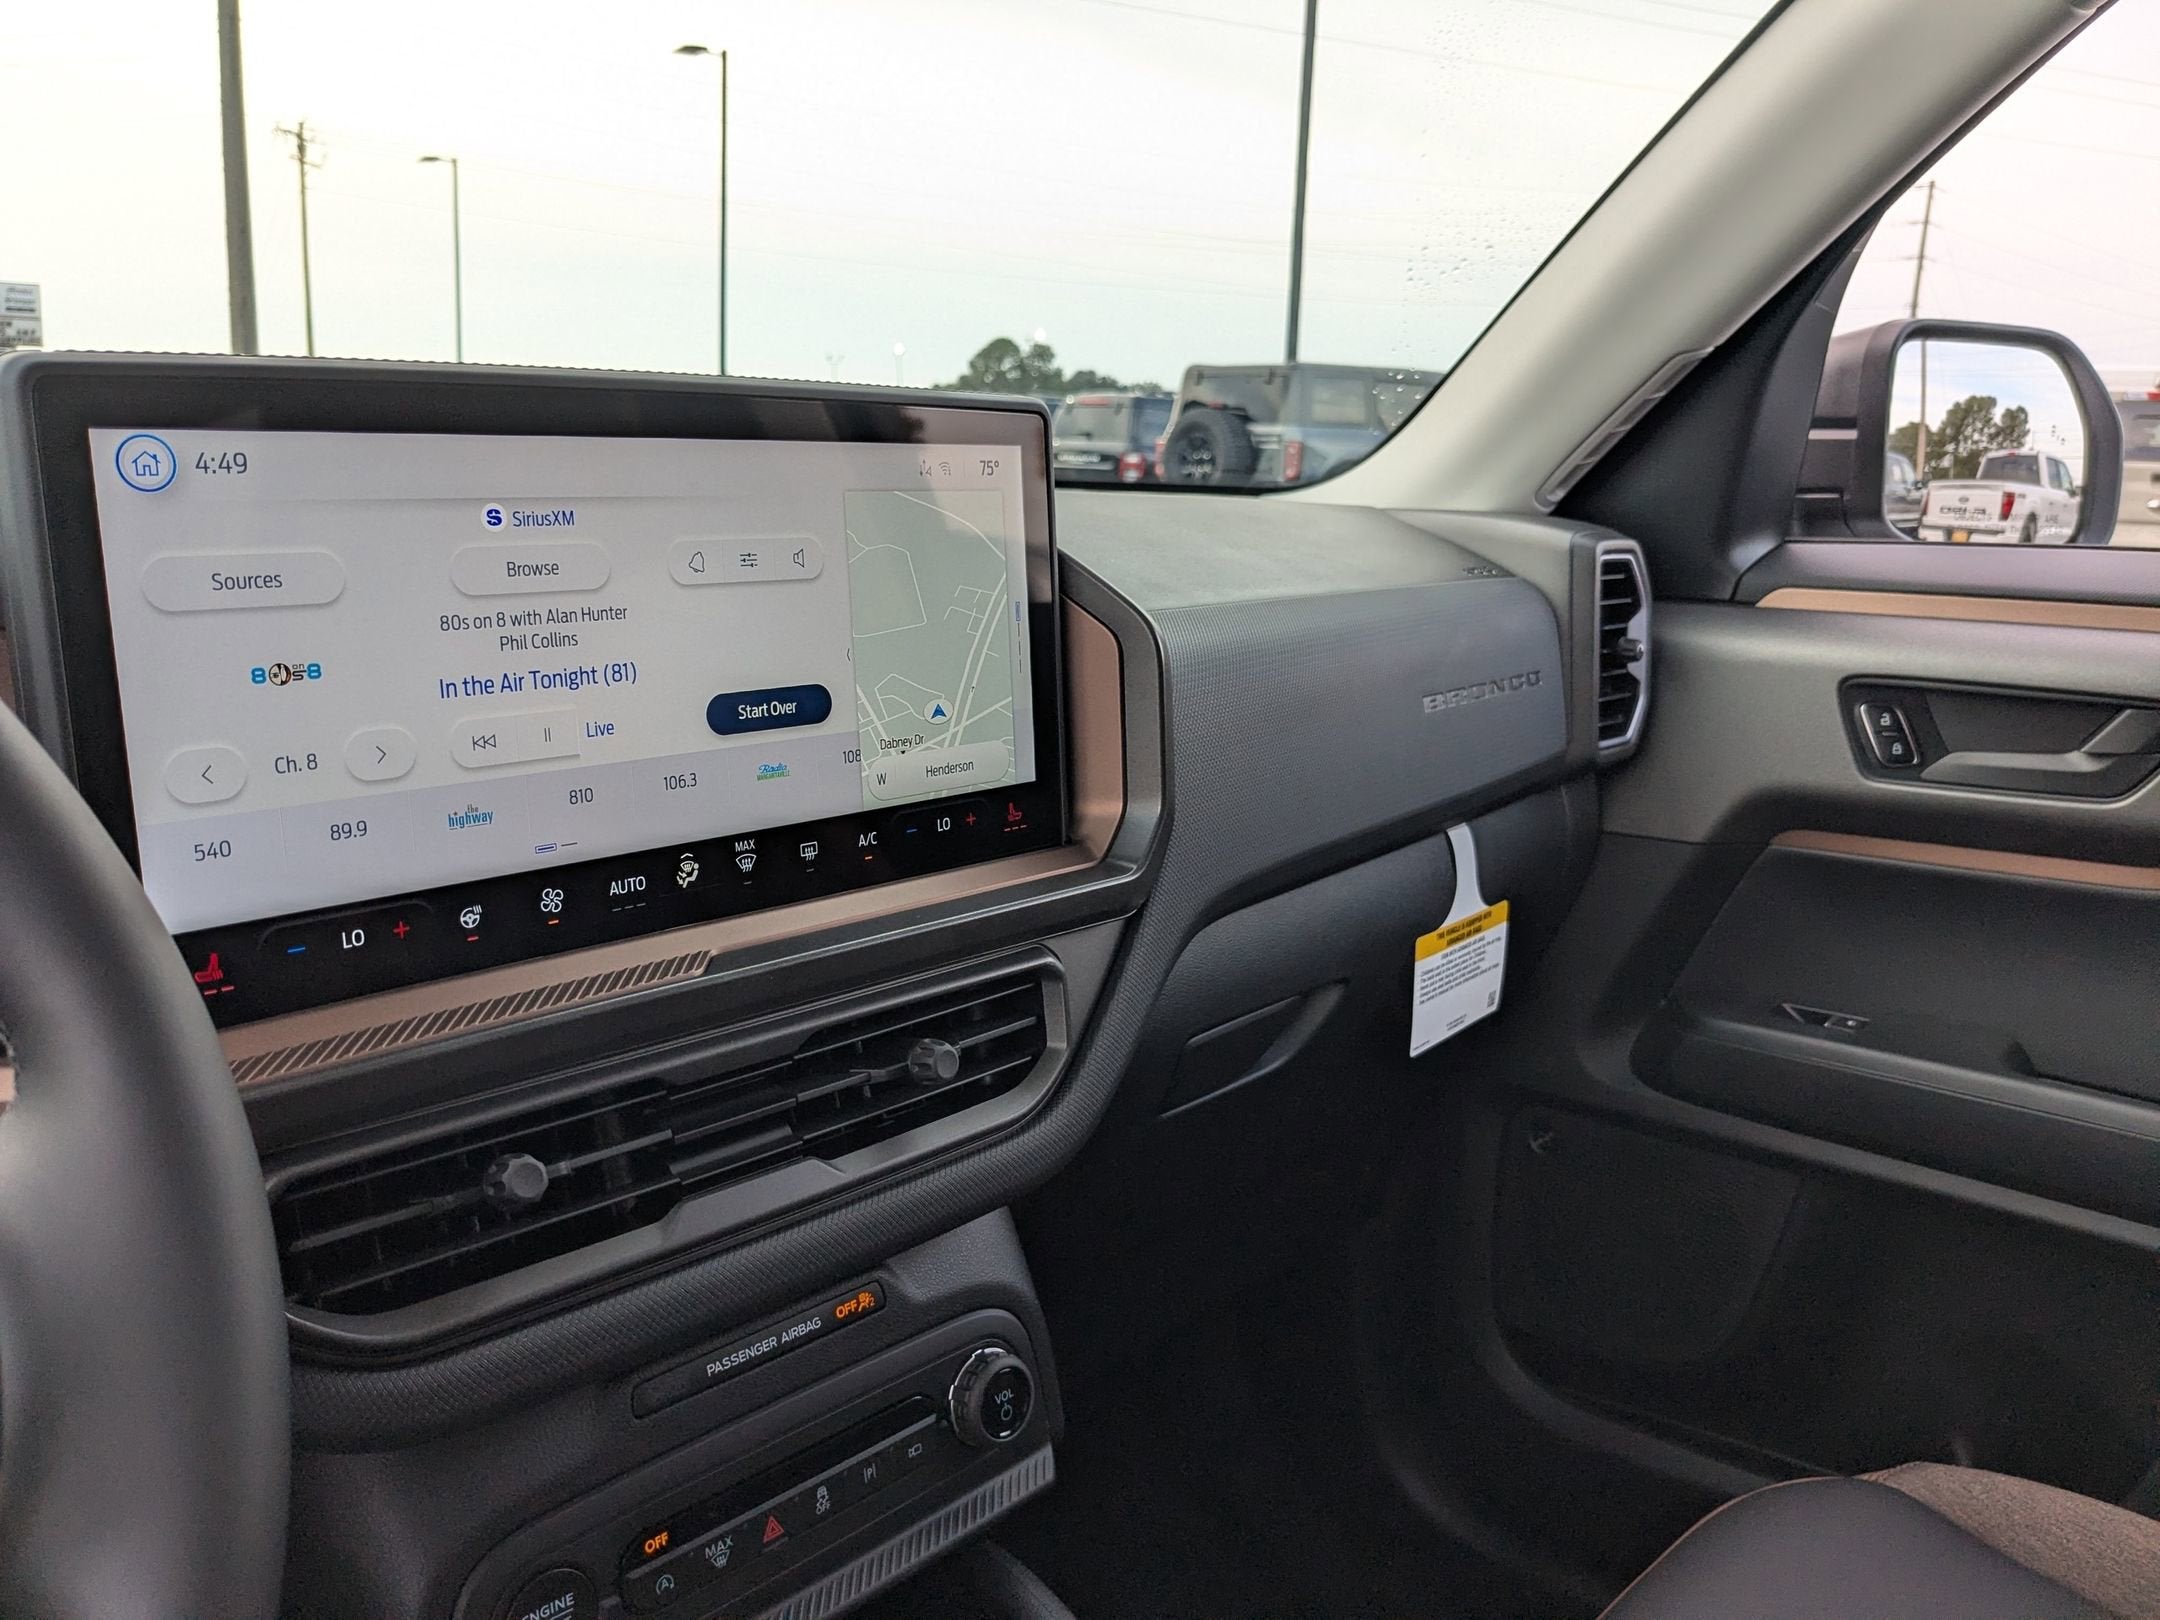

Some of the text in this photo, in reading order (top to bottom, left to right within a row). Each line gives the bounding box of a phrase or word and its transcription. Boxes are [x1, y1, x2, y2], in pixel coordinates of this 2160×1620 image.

[195, 452, 248, 474] 4:49
[512, 510, 575, 527] SiriusXM
[506, 560, 560, 577] Browse
[211, 571, 283, 591] Sources
[440, 605, 628, 631] 80s on 8 with Alan Hunter
[500, 632, 578, 651] Phil Collins
[440, 661, 638, 699] In the Air Tonight (81)
[1422, 670, 1543, 713] BRONCO
[738, 701, 797, 720] Start Over
[586, 722, 615, 738] Live
[880, 734, 925, 751] Dabney Dr
[274, 753, 318, 775] Ch. 8
[926, 760, 974, 778] Henderson
[664, 772, 697, 791] 106.3
[877, 773, 887, 786] W
[569, 788, 594, 805] 810
[448, 811, 494, 829] highway
[937, 817, 950, 832] LO
[330, 820, 368, 841] 89.9
[858, 832, 878, 848] A/C
[194, 840, 231, 861] 540
[735, 839, 756, 852] MAX
[609, 876, 646, 897] AUTO
[342, 929, 365, 950] LO
[836, 1299, 857, 1318] OFF
[706, 1317, 822, 1376] PASSENGER AIRBAG
[995, 1389, 1014, 1405] VOL
[645, 1532, 669, 1553] OFF
[705, 1535, 734, 1559] MAX
